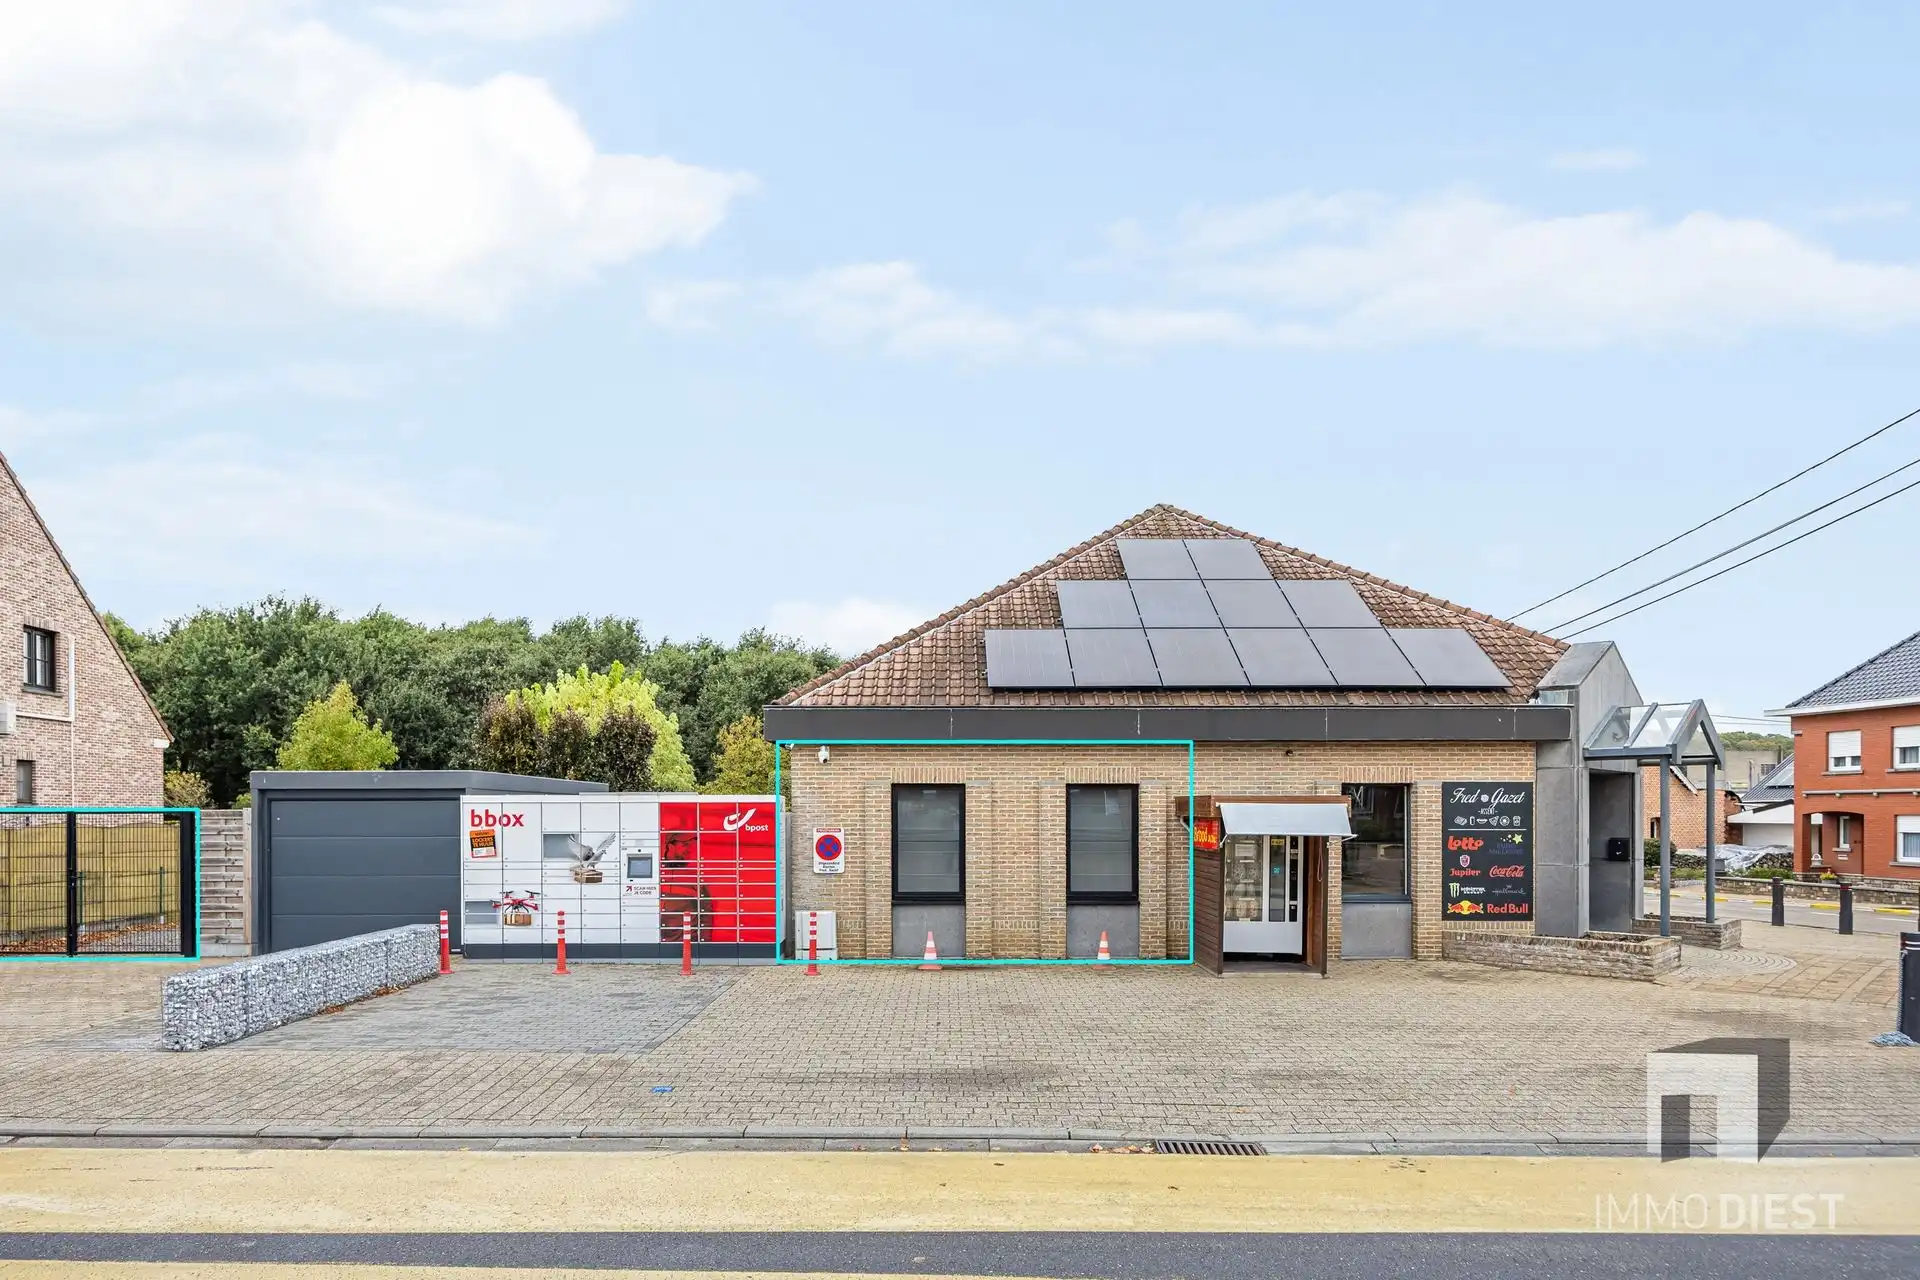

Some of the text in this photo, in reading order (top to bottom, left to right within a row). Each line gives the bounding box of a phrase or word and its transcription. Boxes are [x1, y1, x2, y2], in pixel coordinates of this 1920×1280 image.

[1450, 787, 1525, 809] Fred Gazet
[470, 809, 524, 827] bbox
[745, 824, 769, 832] bpost
[1449, 867, 1481, 878] Jupiler
[1492, 888, 1526, 896] Hallmark
[1487, 903, 1529, 914] Red Bull
